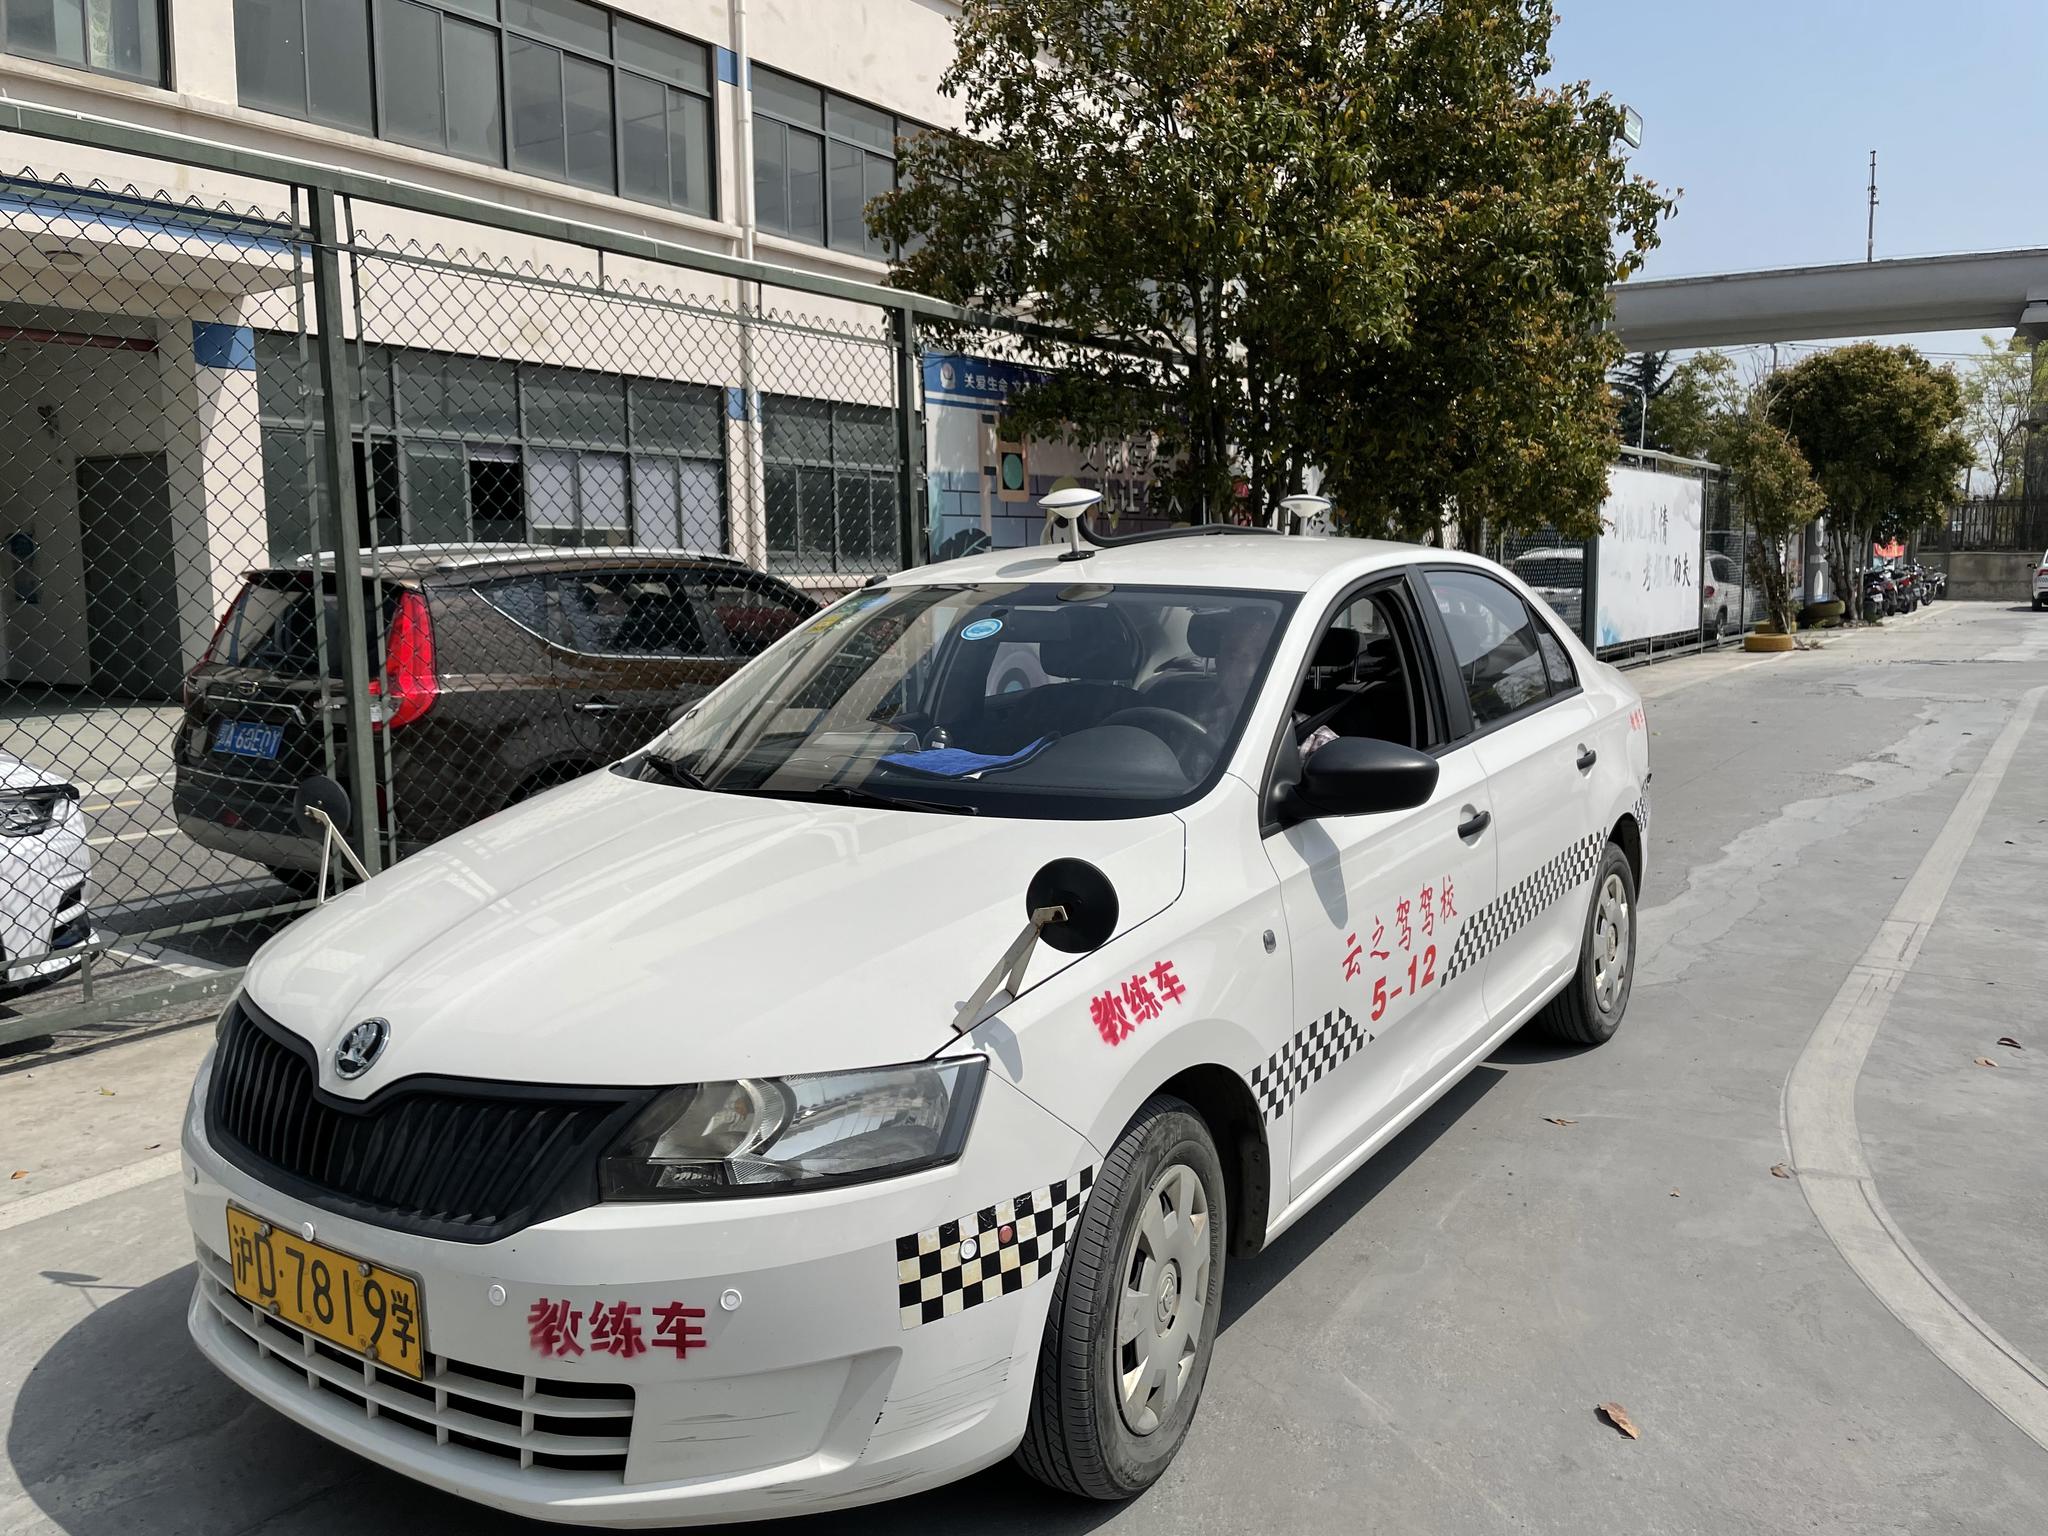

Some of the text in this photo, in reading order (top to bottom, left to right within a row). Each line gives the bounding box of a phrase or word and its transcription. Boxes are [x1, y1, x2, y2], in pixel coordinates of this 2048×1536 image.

[964, 372, 1008, 392] 关爱生命
[1342, 874, 1457, 982] 云之驾驾校
[1089, 960, 1186, 1047] 教练车
[1371, 944, 1437, 1021] 5-12
[528, 1297, 707, 1359] 教练车
